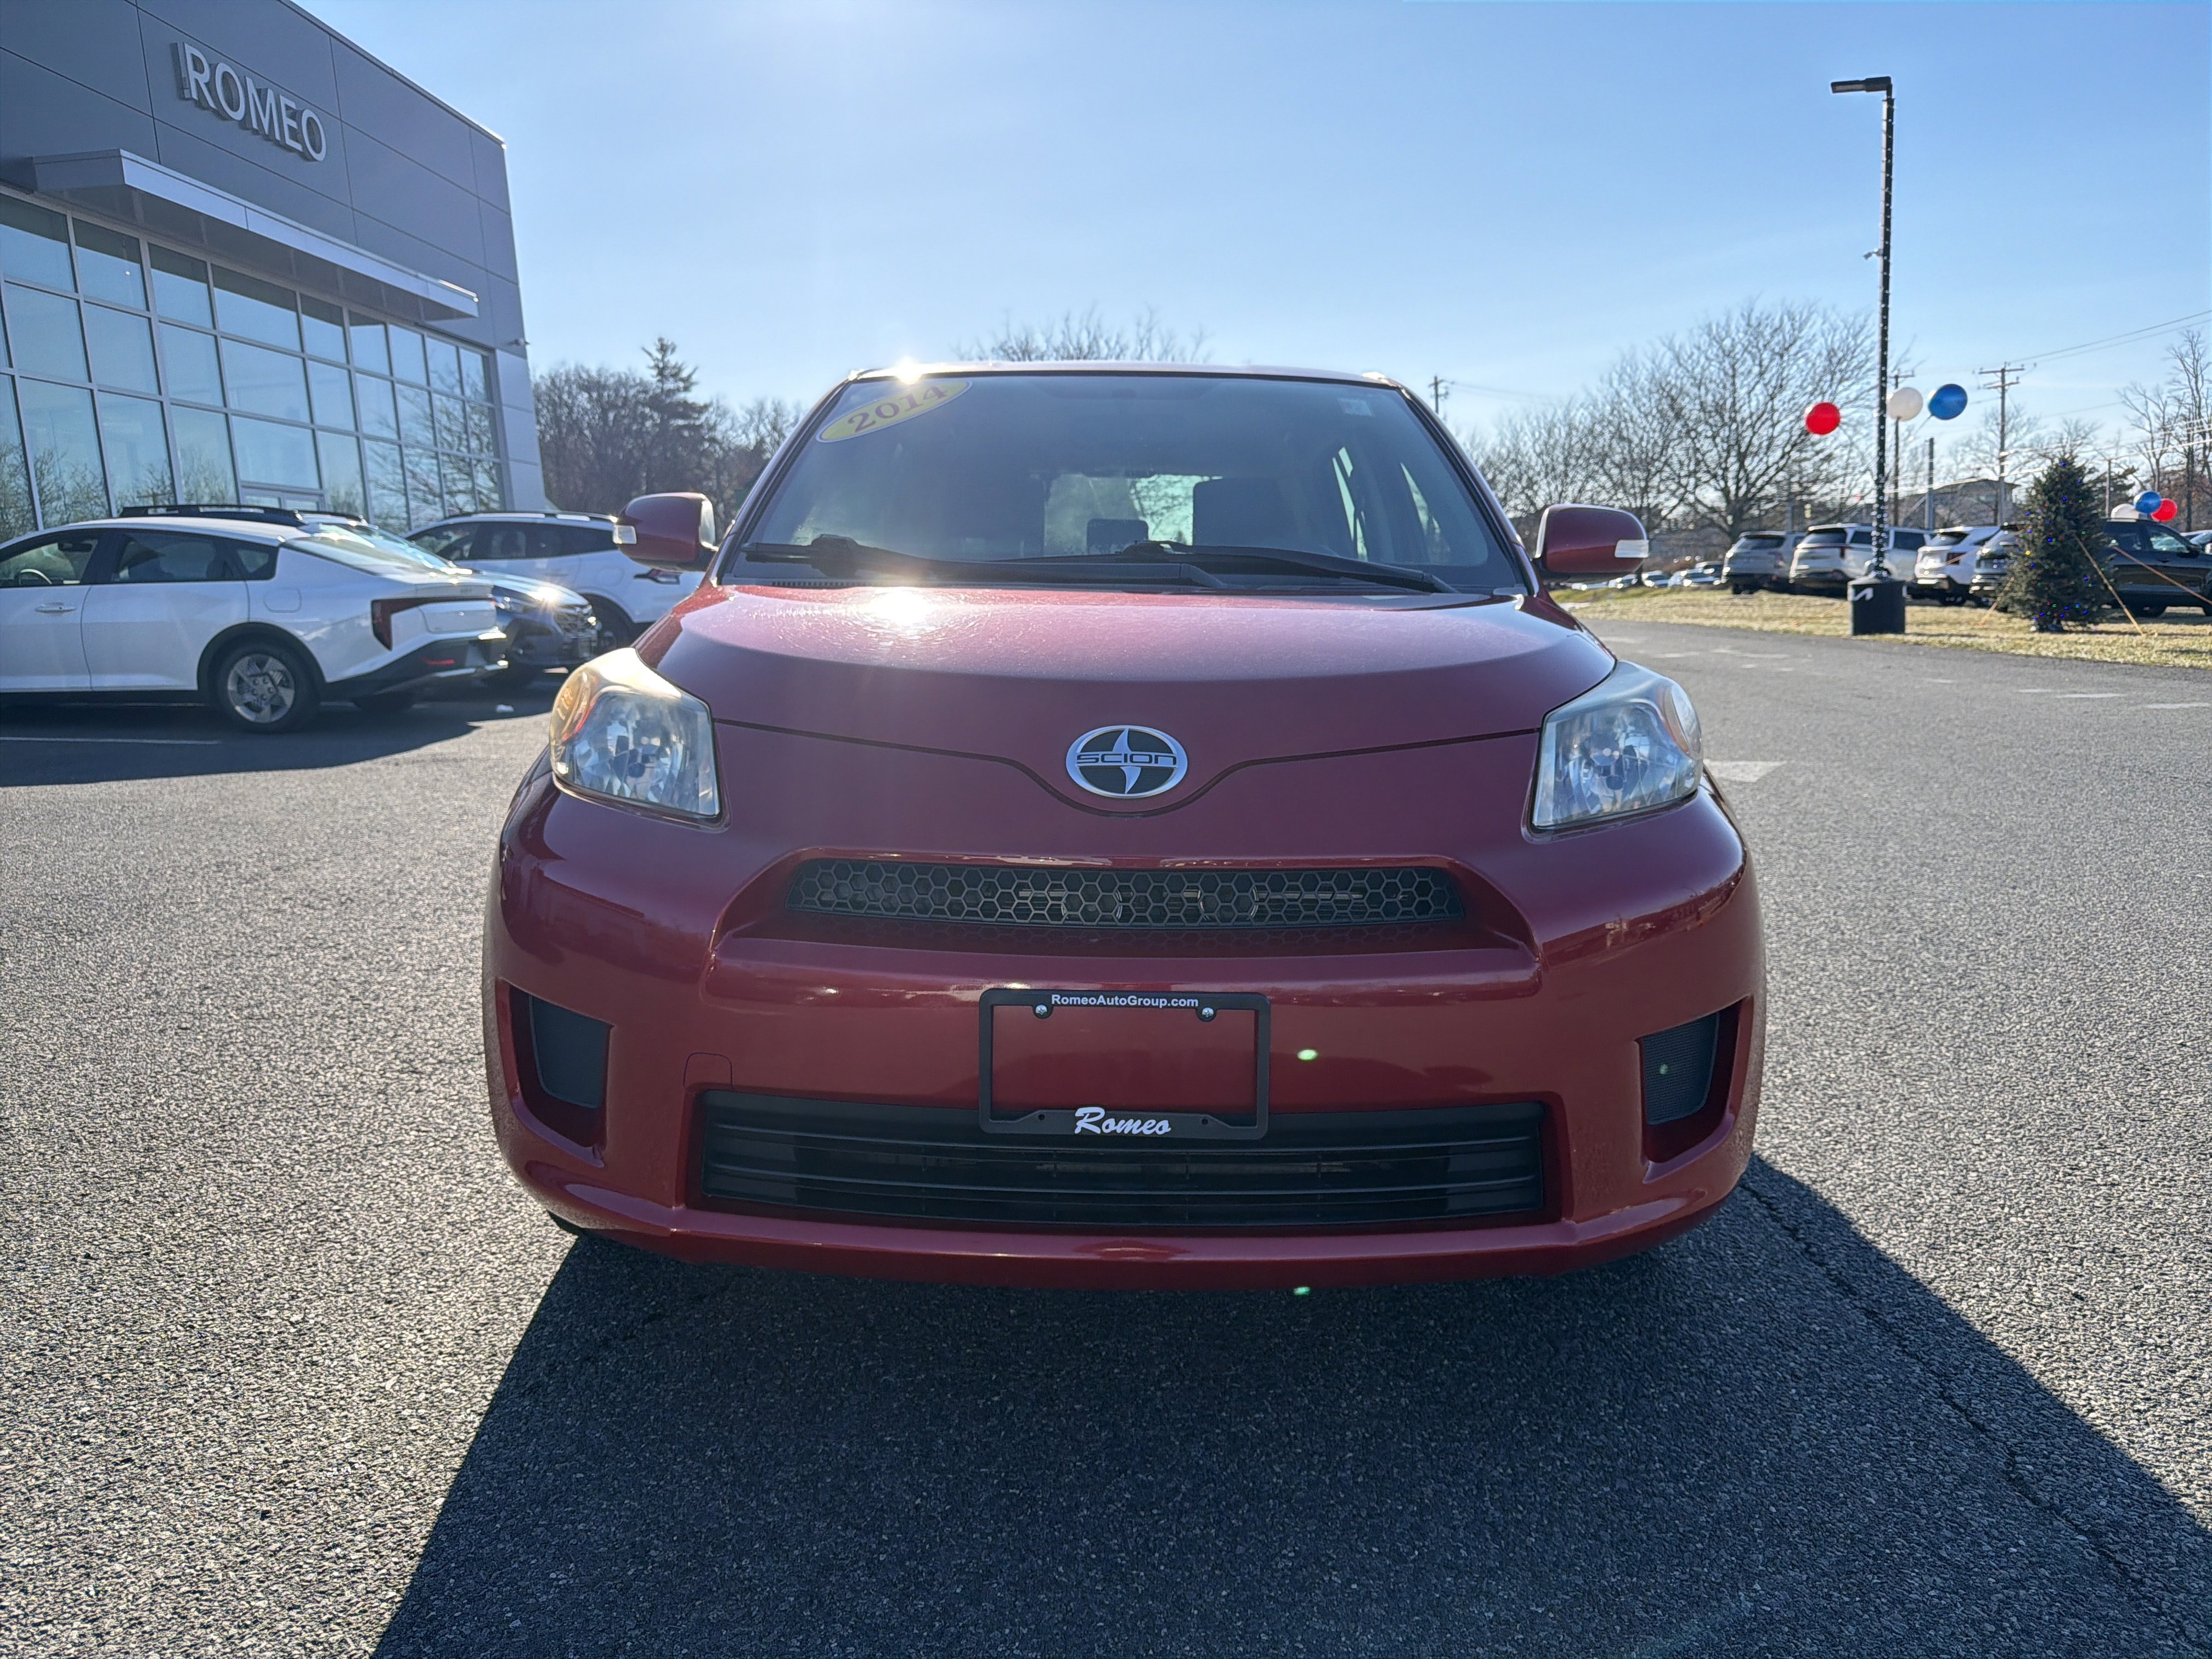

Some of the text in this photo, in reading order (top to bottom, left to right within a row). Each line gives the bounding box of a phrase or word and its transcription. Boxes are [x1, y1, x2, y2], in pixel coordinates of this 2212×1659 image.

[181, 42, 327, 162] ROMEO
[847, 385, 947, 433] 2014
[1076, 753, 1177, 766] SCION
[1051, 994, 1199, 1008] RomeoAutoGroup.com
[1074, 1107, 1172, 1135] Romeo
